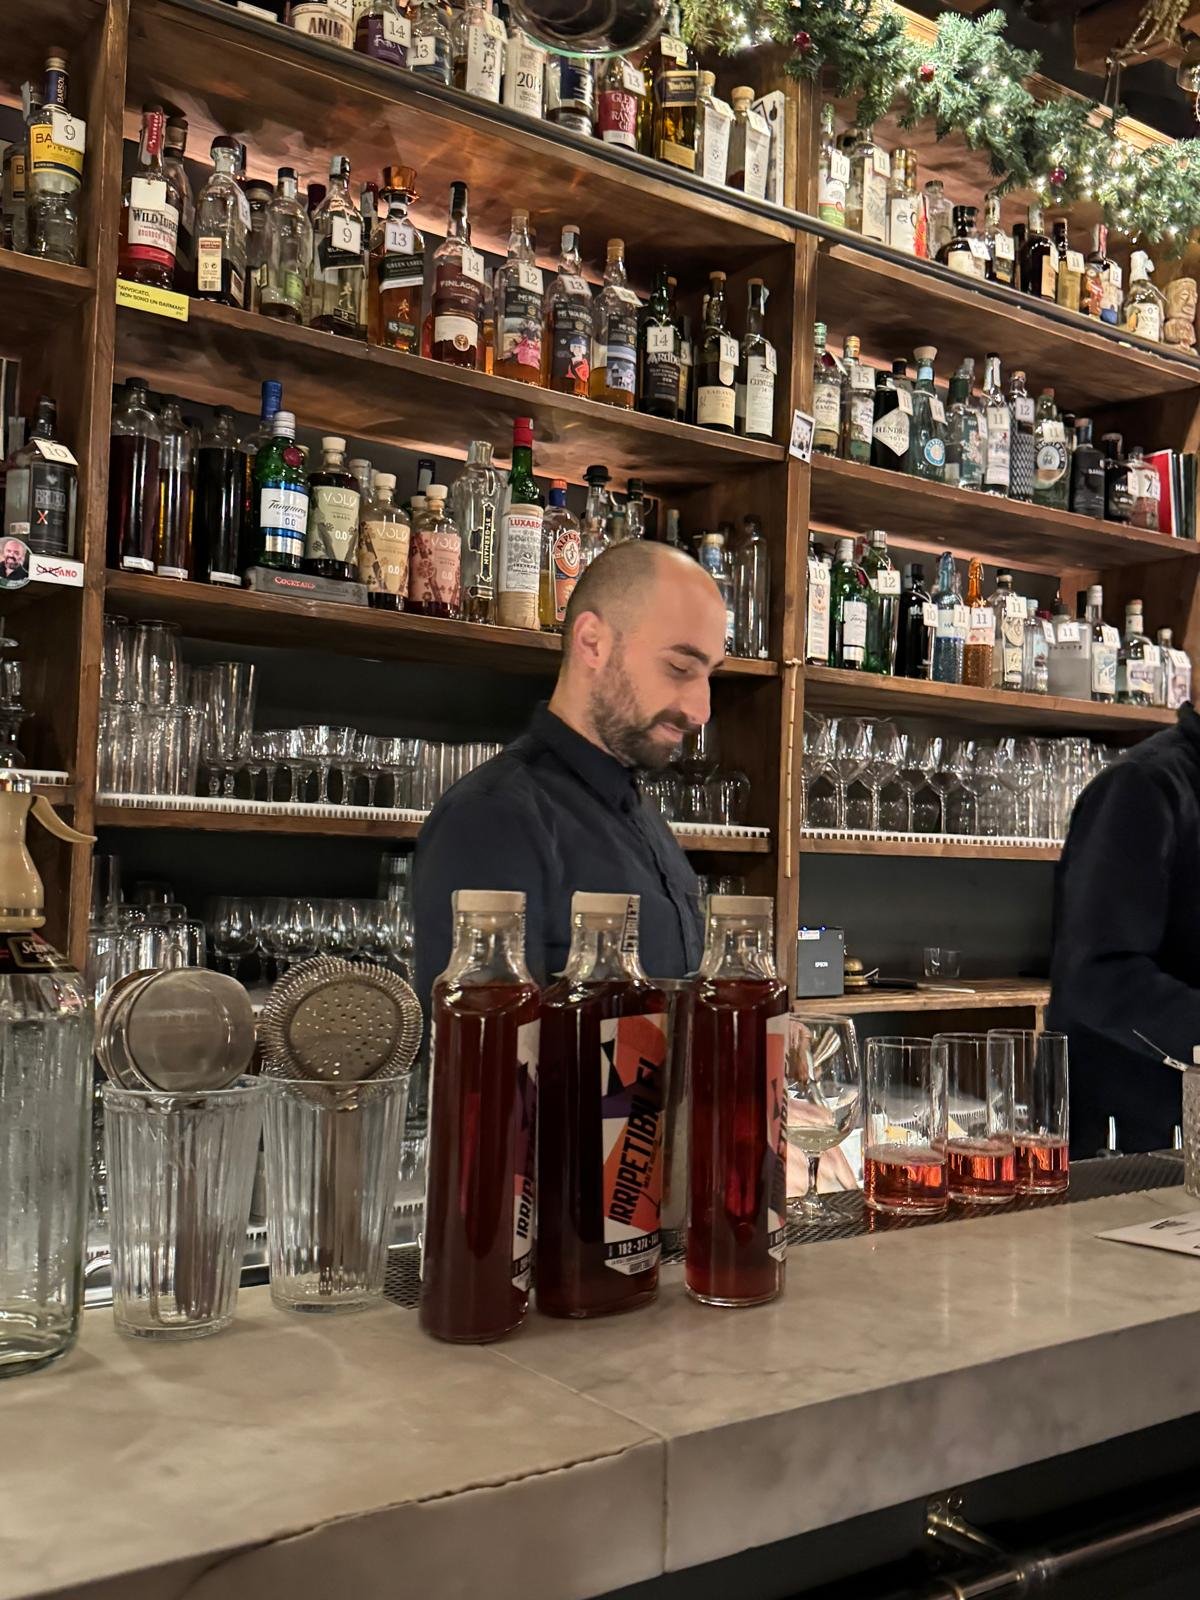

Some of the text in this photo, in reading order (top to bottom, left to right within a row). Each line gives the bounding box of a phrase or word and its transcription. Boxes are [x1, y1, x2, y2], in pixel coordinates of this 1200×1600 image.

[391, 21, 406, 38] 14
[413, 44, 429, 59] 13
[628, 72, 641, 87] 13
[64, 124, 76, 141] 9
[132, 208, 159, 223] WILD
[342, 228, 353, 244] 9
[391, 231, 408, 247] 13
[466, 257, 480, 276] 14
[525, 270, 537, 285] 12
[570, 279, 583, 291] 13
[388, 321, 399, 331] 15
[653, 333, 667, 347] 14
[723, 344, 736, 358] 16
[856, 372, 869, 384] 15
[1019, 404, 1030, 416] 12
[994, 413, 1003, 425] 11
[45, 445, 68, 459] 10
[335, 530, 348, 541] 0.0
[388, 564, 400, 575] 0.0
[813, 568, 826, 580] 10
[883, 576, 896, 588] 12
[926, 608, 935, 622] 10
[976, 613, 987, 625] 11
